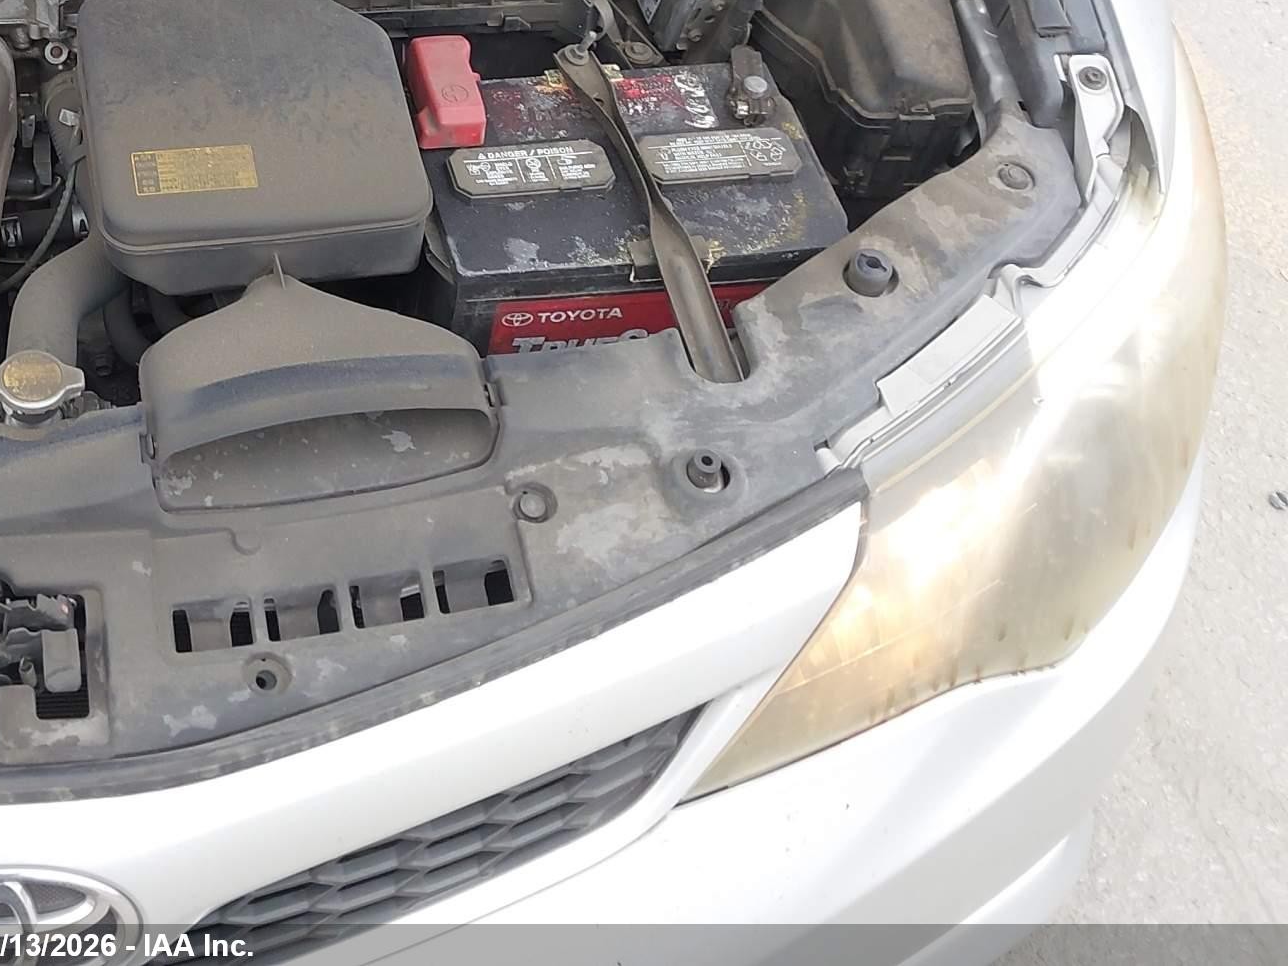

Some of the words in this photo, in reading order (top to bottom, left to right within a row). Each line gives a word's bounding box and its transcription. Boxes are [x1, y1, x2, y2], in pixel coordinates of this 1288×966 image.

[487, 150, 529, 159] DANGER
[536, 146, 574, 156] POISON
[538, 307, 623, 324] TOYOTA
